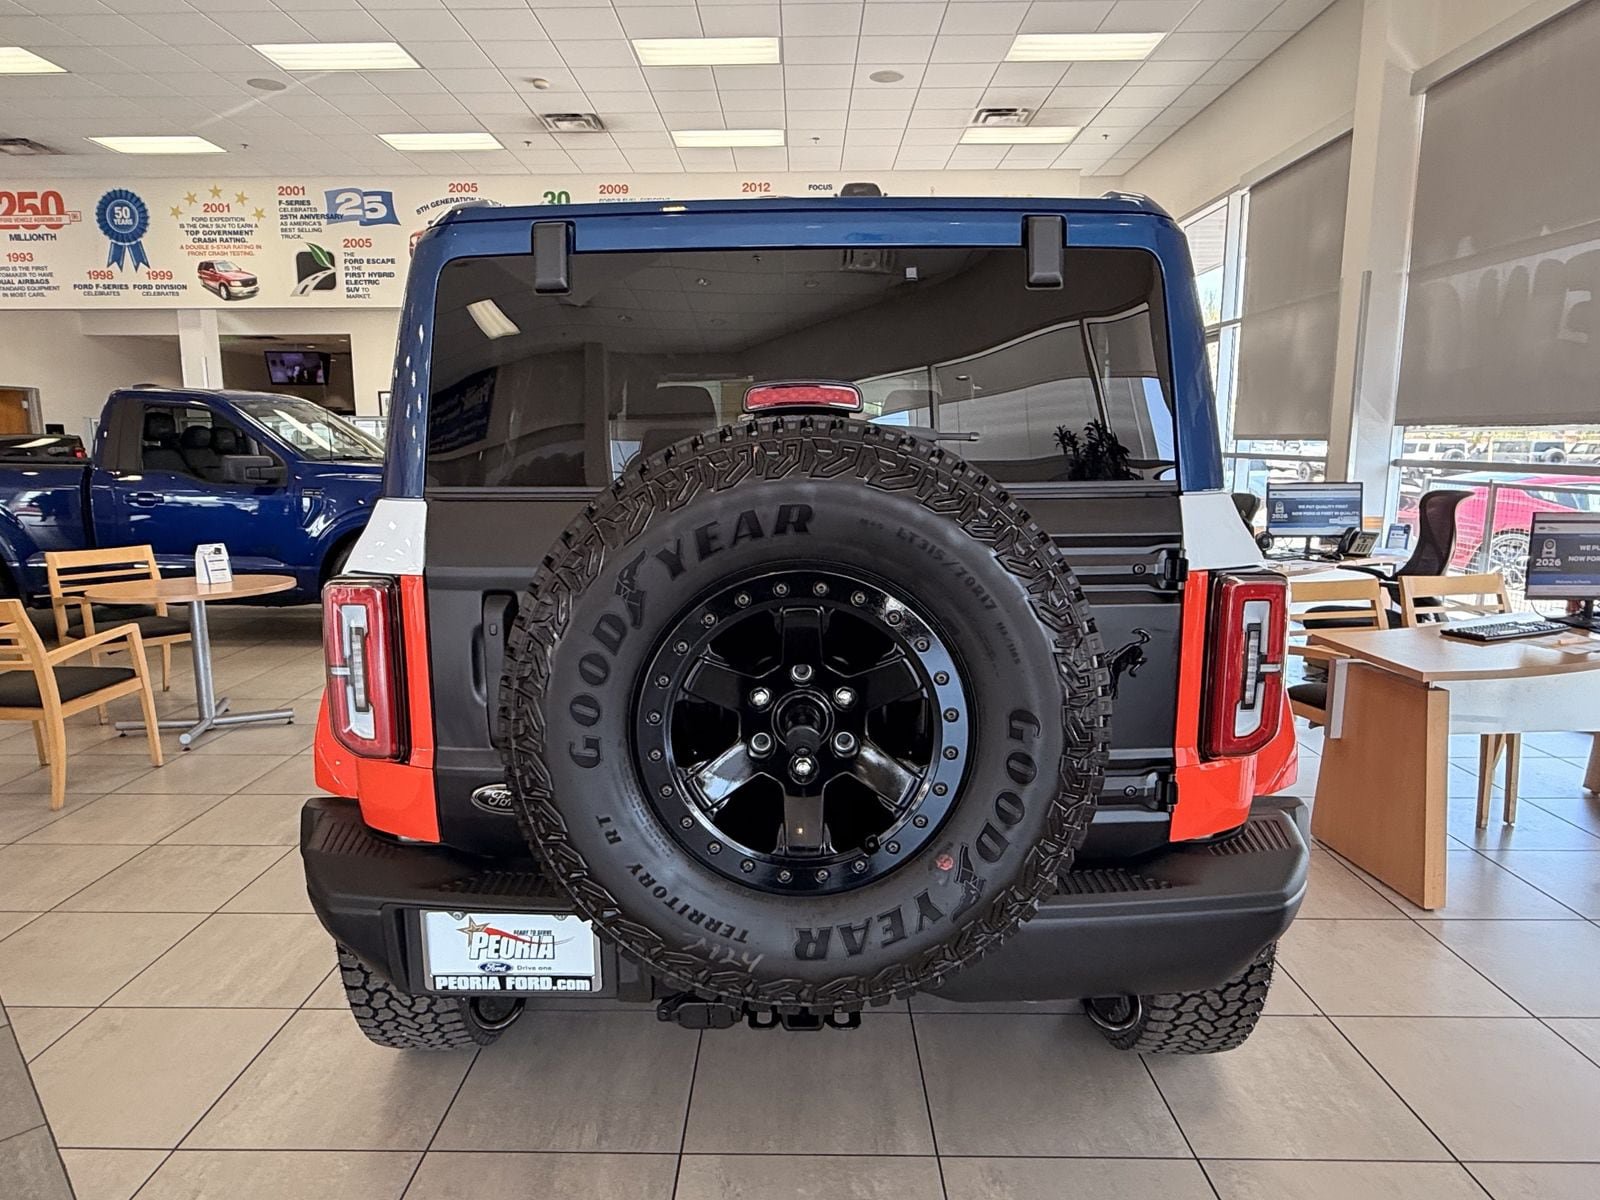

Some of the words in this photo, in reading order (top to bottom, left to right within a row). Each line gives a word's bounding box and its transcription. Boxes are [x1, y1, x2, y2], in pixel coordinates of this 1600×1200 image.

[278, 186, 306, 196] 2001
[448, 183, 478, 193] 2005
[599, 184, 629, 195] 2009
[742, 182, 771, 193] 2012
[0, 190, 65, 230] 250
[202, 203, 231, 213] 2001
[335, 191, 388, 220] 25
[114, 206, 131, 219] 50
[9, 233, 57, 241] MILLIONTH
[343, 238, 372, 248] 2005
[6, 252, 34, 262] 1993
[86, 270, 114, 280] 1998
[145, 270, 174, 280] 1999
[1535, 558, 1561, 567] 2026
[596, 815, 623, 846] RT
[626, 862, 750, 944] TERRITORY
[469, 931, 555, 960] PEORIA
[483, 962, 509, 973] Ford
[435, 976, 501, 991] PEORIA
[505, 976, 591, 992] FORD.com
